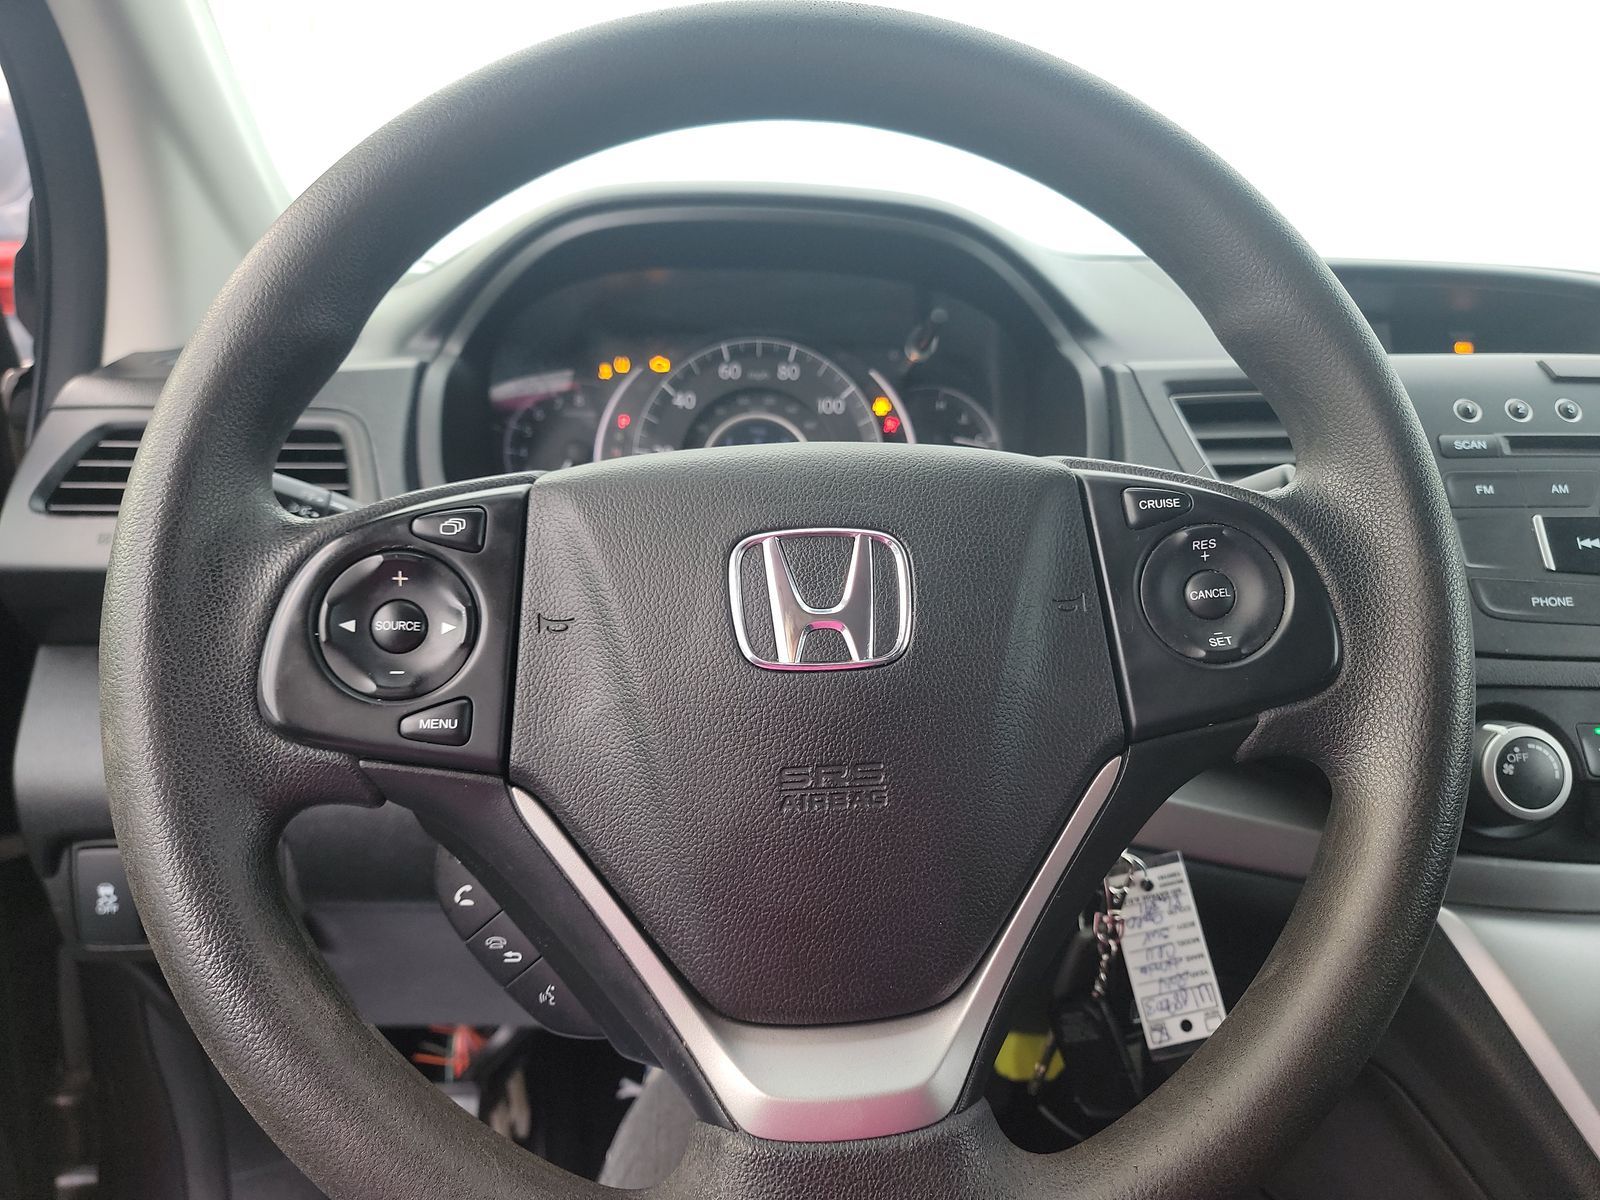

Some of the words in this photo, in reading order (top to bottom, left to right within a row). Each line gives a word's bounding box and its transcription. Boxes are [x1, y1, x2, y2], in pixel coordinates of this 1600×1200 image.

[718, 361, 741, 380] 60
[777, 361, 800, 381] 80
[671, 391, 697, 410] 40
[817, 397, 845, 415] 100
[1453, 440, 1488, 450] SCAN
[1475, 484, 1495, 495] FM
[1551, 484, 1570, 494] AM
[1138, 498, 1181, 510] CRUISE
[1192, 538, 1217, 550] RES
[1189, 588, 1231, 601] CANCEL
[1531, 596, 1574, 607] PHONE
[375, 620, 421, 632] SOURCE
[1208, 635, 1233, 647] SET
[418, 718, 458, 730] MENU
[1506, 752, 1529, 764] OFF
[779, 762, 885, 791] SRS
[778, 790, 889, 812] AIRBAG
